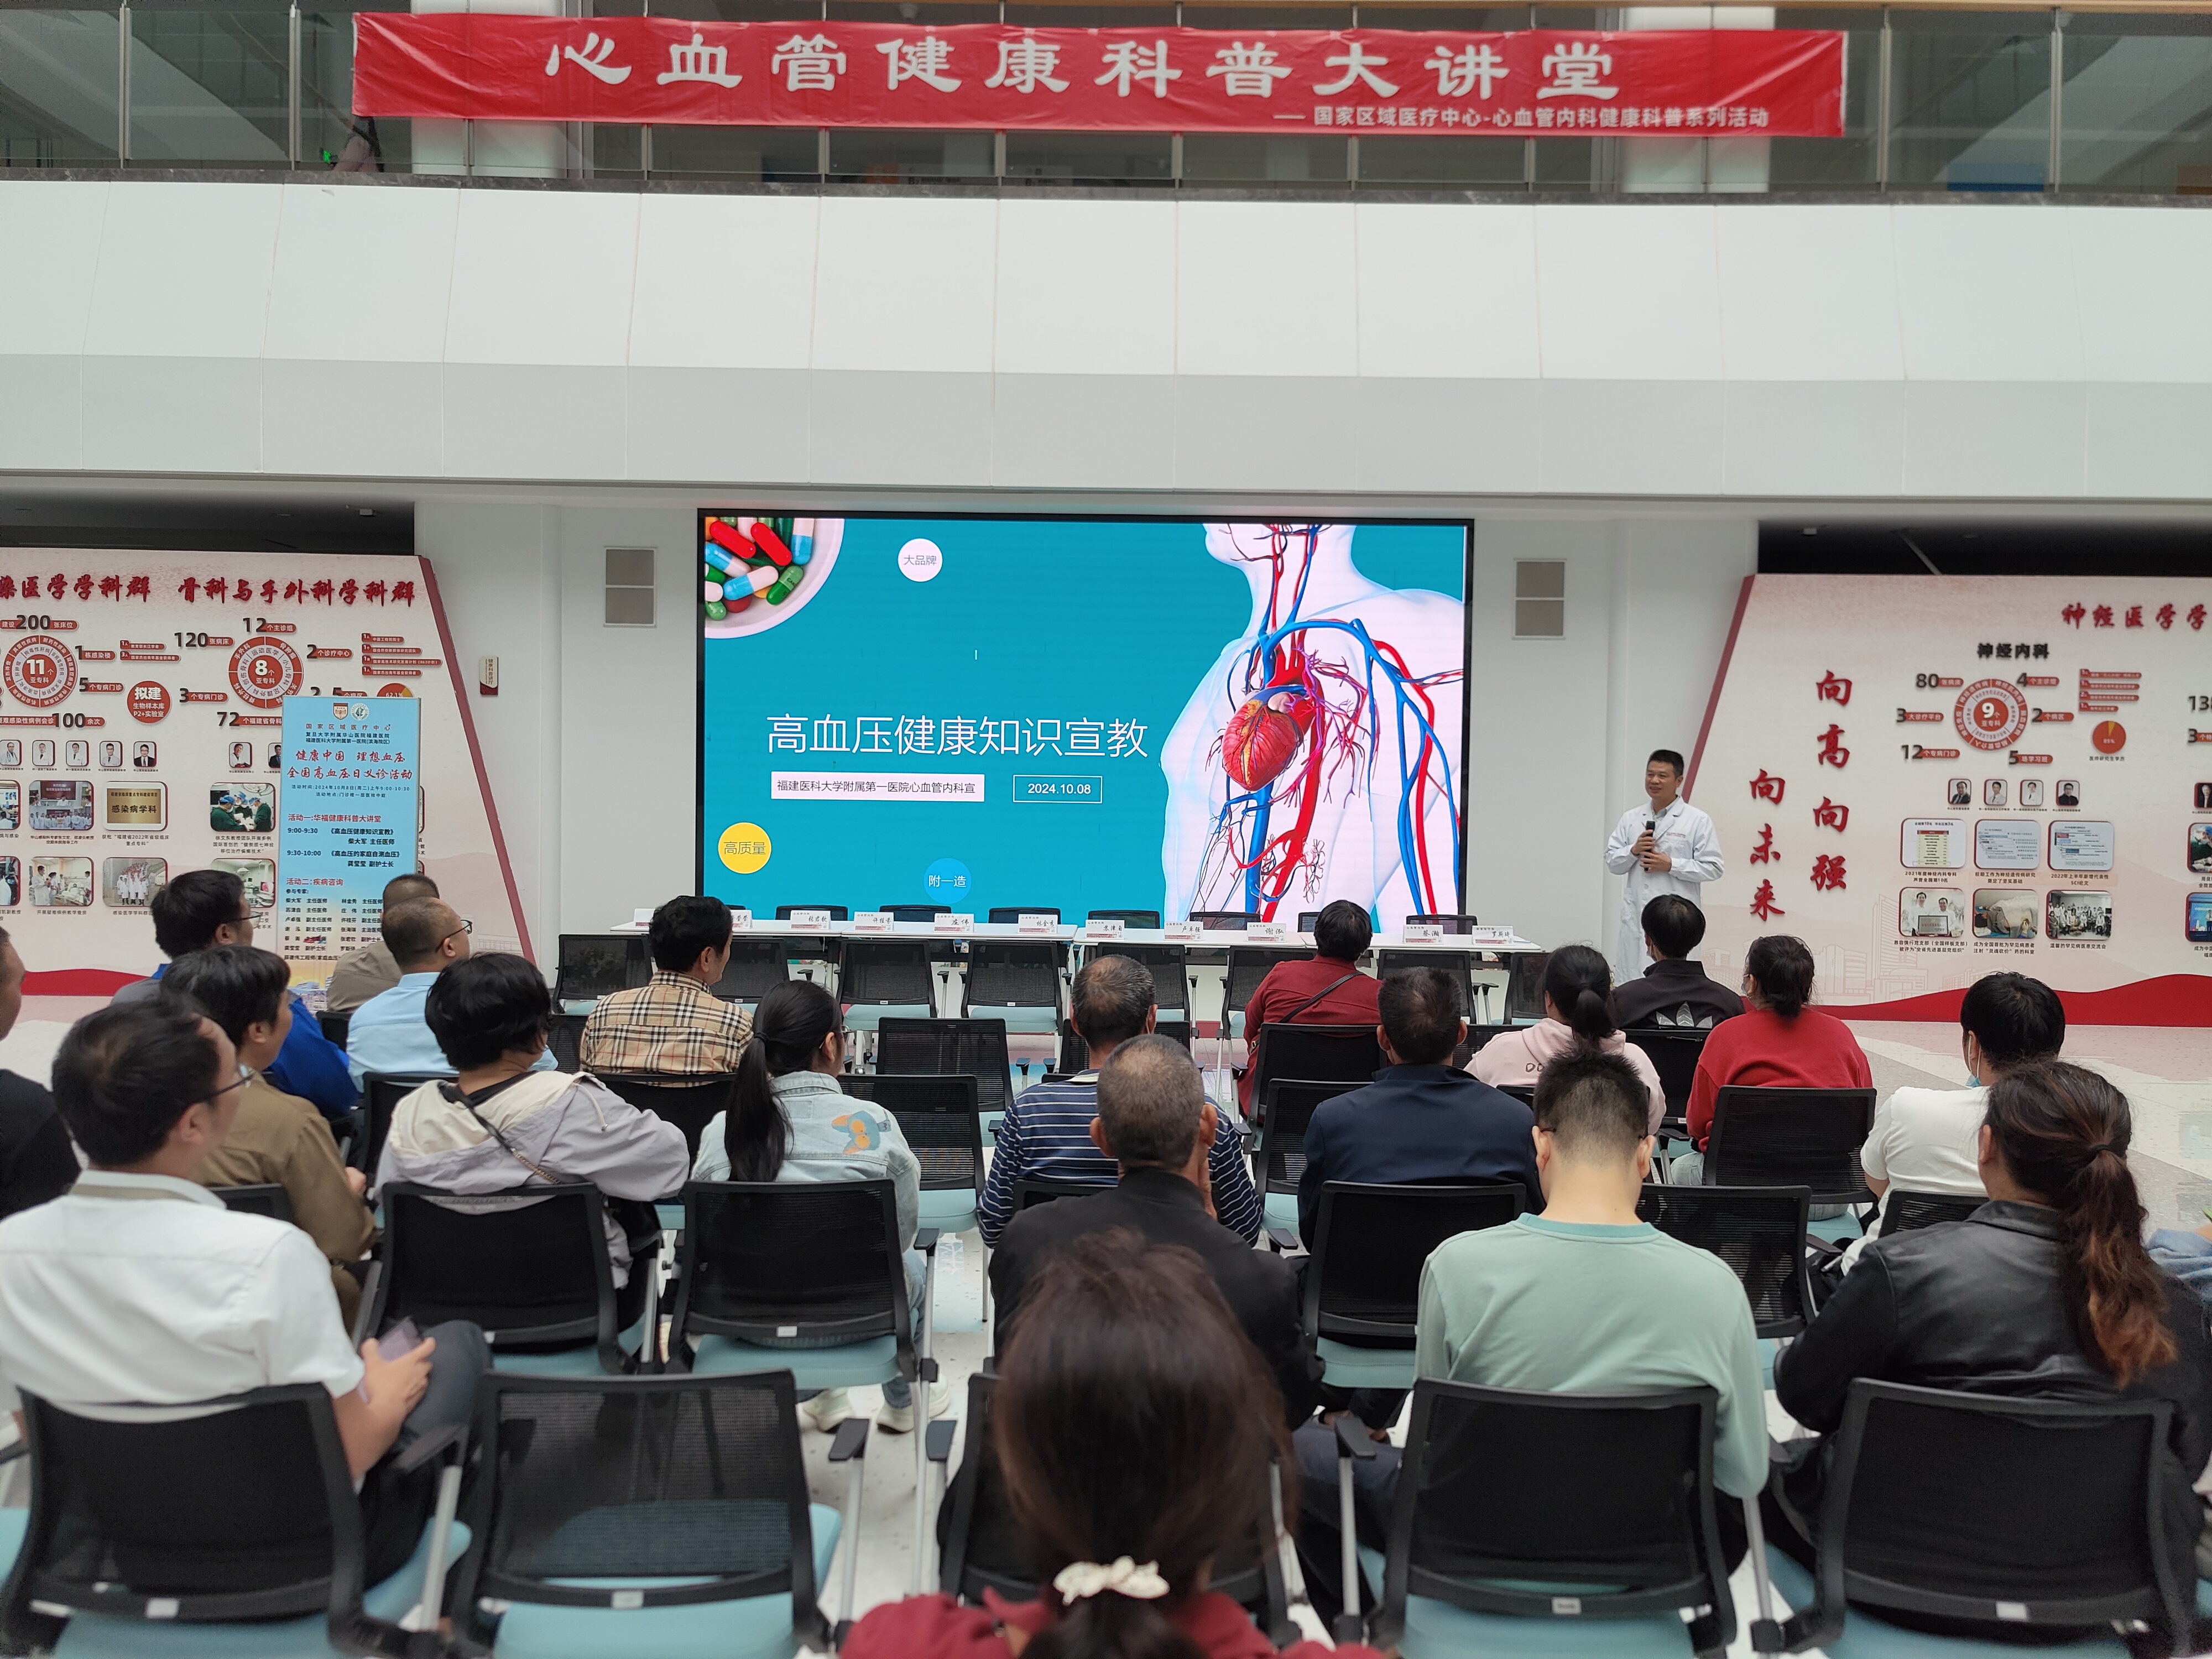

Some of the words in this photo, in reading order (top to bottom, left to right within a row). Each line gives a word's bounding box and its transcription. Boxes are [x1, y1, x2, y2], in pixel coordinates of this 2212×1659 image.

[545, 32, 1620, 101] 心血管健康科普大讲堂
[903, 554, 938, 567] 大品牌
[178, 577, 415, 608] 骨科与手外科学科群
[16, 614, 51, 630] 200
[174, 632, 209, 648] 120
[234, 643, 251, 660] 手外科
[252, 647, 279, 656] 运动医学
[306, 644, 317, 659] 2
[1976, 643, 2049, 659] 神经内科
[27, 659, 45, 675] 11
[255, 660, 268, 676] 8
[80, 677, 89, 692] 5
[1916, 673, 1939, 688] 80
[2016, 672, 2027, 687] 4
[134, 686, 162, 701] 拟建
[179, 688, 189, 703] 3
[1896, 708, 1907, 722] 3
[1982, 702, 1995, 718] 9
[2031, 708, 2043, 722] 2
[51, 712, 86, 728] 100
[217, 711, 240, 727] 72
[766, 713, 1150, 759] 高血压健康知识宣教
[296, 749, 345, 761] 健康中国
[356, 750, 405, 763] 理想血压
[1901, 744, 1923, 759] 12
[2008, 750, 2020, 765] 5
[286, 766, 413, 780] 全国高血压日义诊活动
[776, 779, 977, 795] 福建医科大学附属第一医院心血管内科宣
[1027, 782, 1092, 795] 2024.10.08
[112, 805, 157, 813] 感染病学科
[288, 813, 382, 823] 活动一:华福健康科普大讲堂
[723, 840, 767, 856] 高质量
[1749, 768, 1786, 922] 向未来
[928, 874, 967, 889] 附一造
